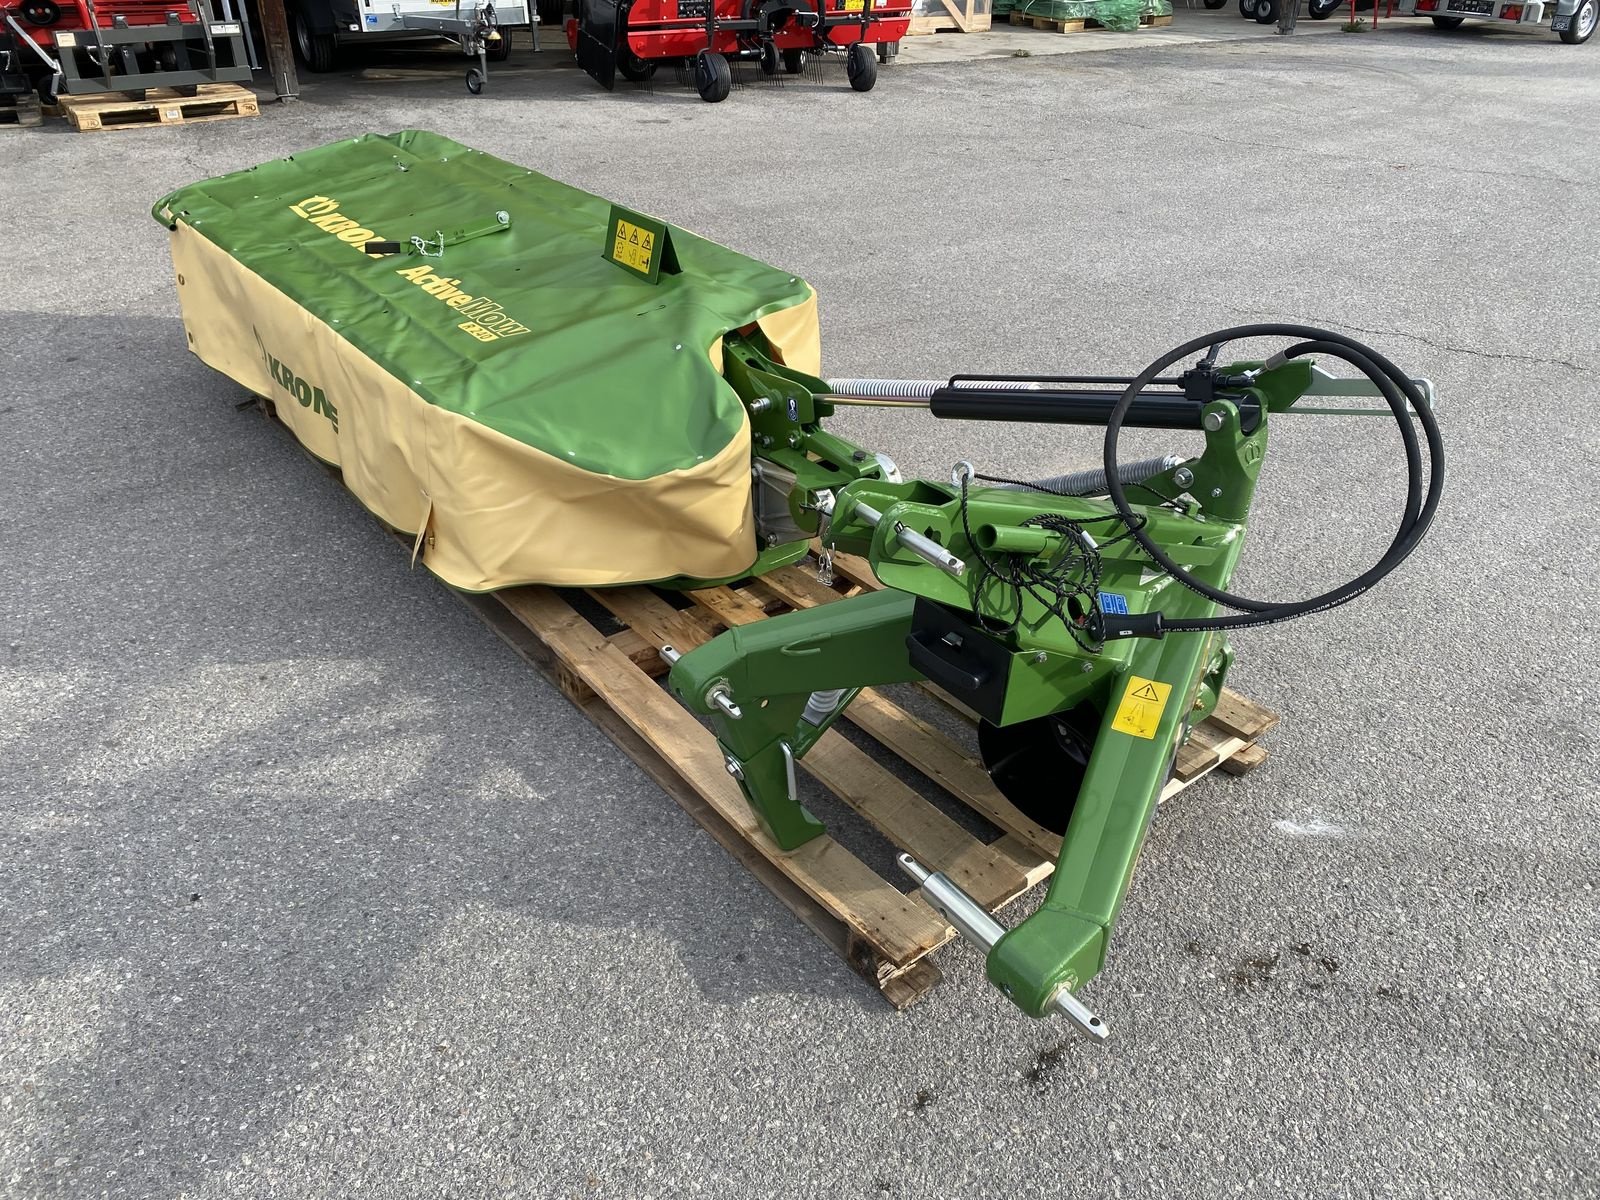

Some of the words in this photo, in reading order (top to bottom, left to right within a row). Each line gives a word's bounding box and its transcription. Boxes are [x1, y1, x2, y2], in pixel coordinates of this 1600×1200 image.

[308, 212, 394, 259] KRON
[396, 264, 531, 337] ActiveMow
[470, 328, 493, 339] 240
[267, 353, 339, 435] KRONE
